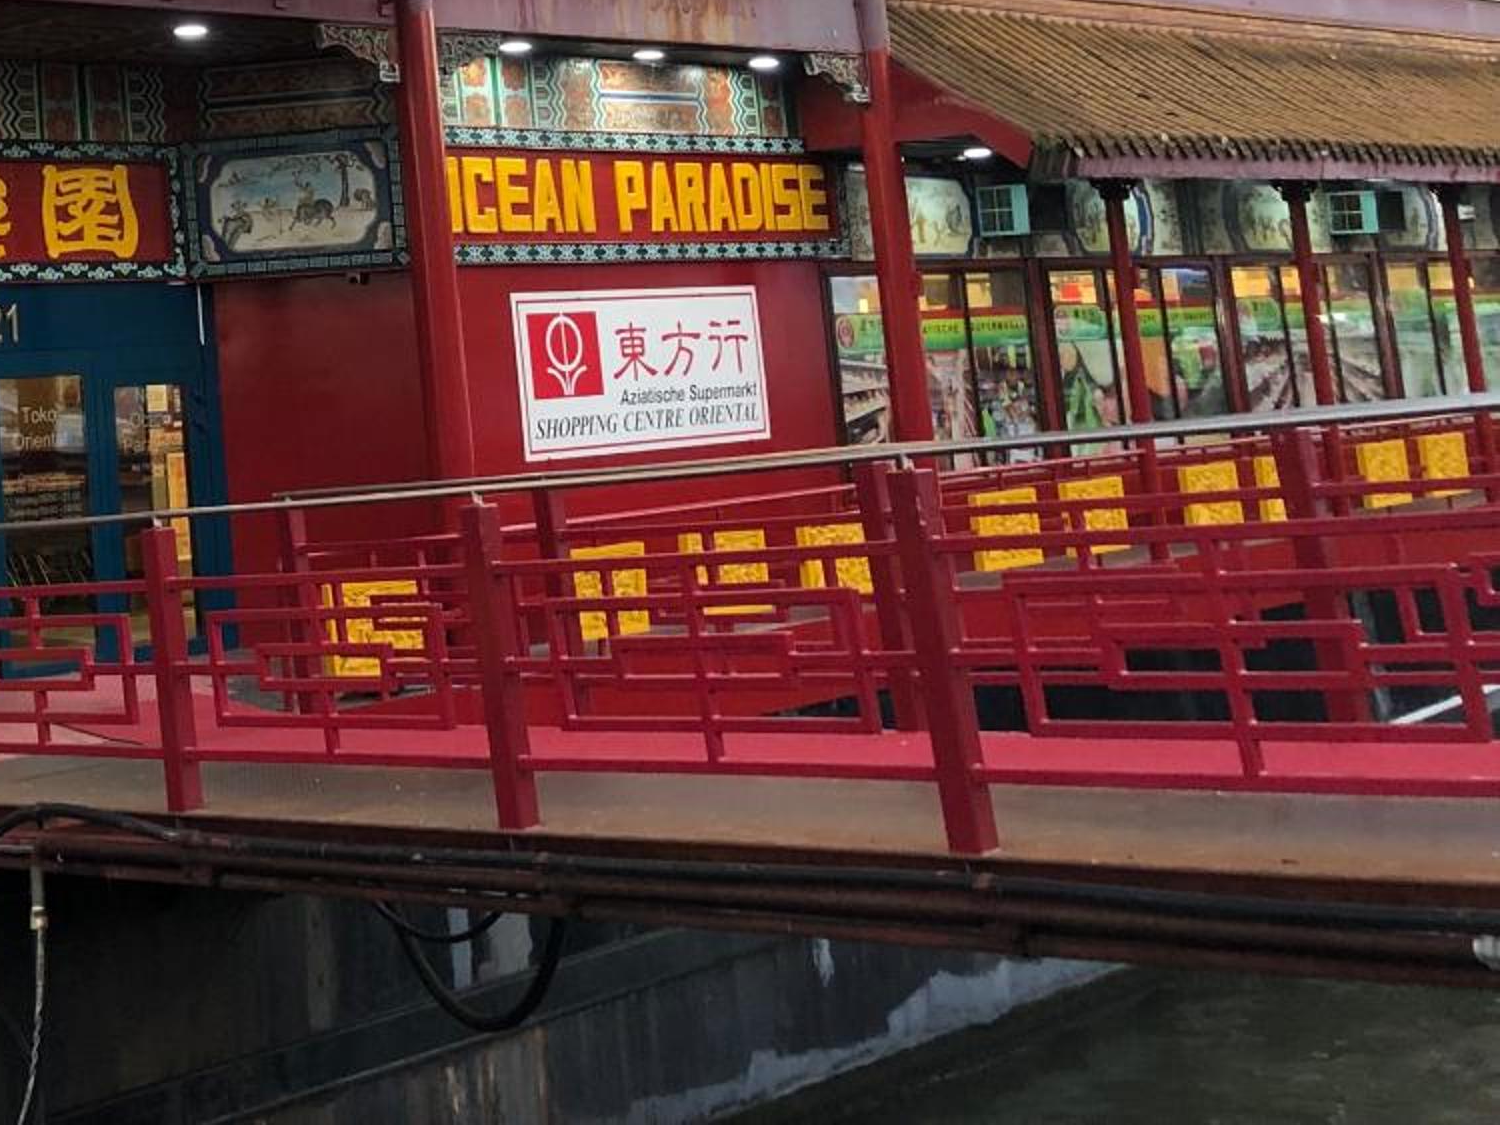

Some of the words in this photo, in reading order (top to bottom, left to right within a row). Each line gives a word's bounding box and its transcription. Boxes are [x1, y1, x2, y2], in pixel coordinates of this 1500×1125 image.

[614, 160, 830, 234] PARADISE
[613, 319, 749, 382] 東方行
[620, 387, 686, 405] Aziatische
[689, 382, 758, 405] Supermarkt
[22, 406, 58, 424] Toko
[534, 411, 619, 441] SHOPPING
[624, 405, 684, 434] CENTRE
[689, 401, 760, 428] ORIENTAL
[15, 432, 69, 450] Orient
